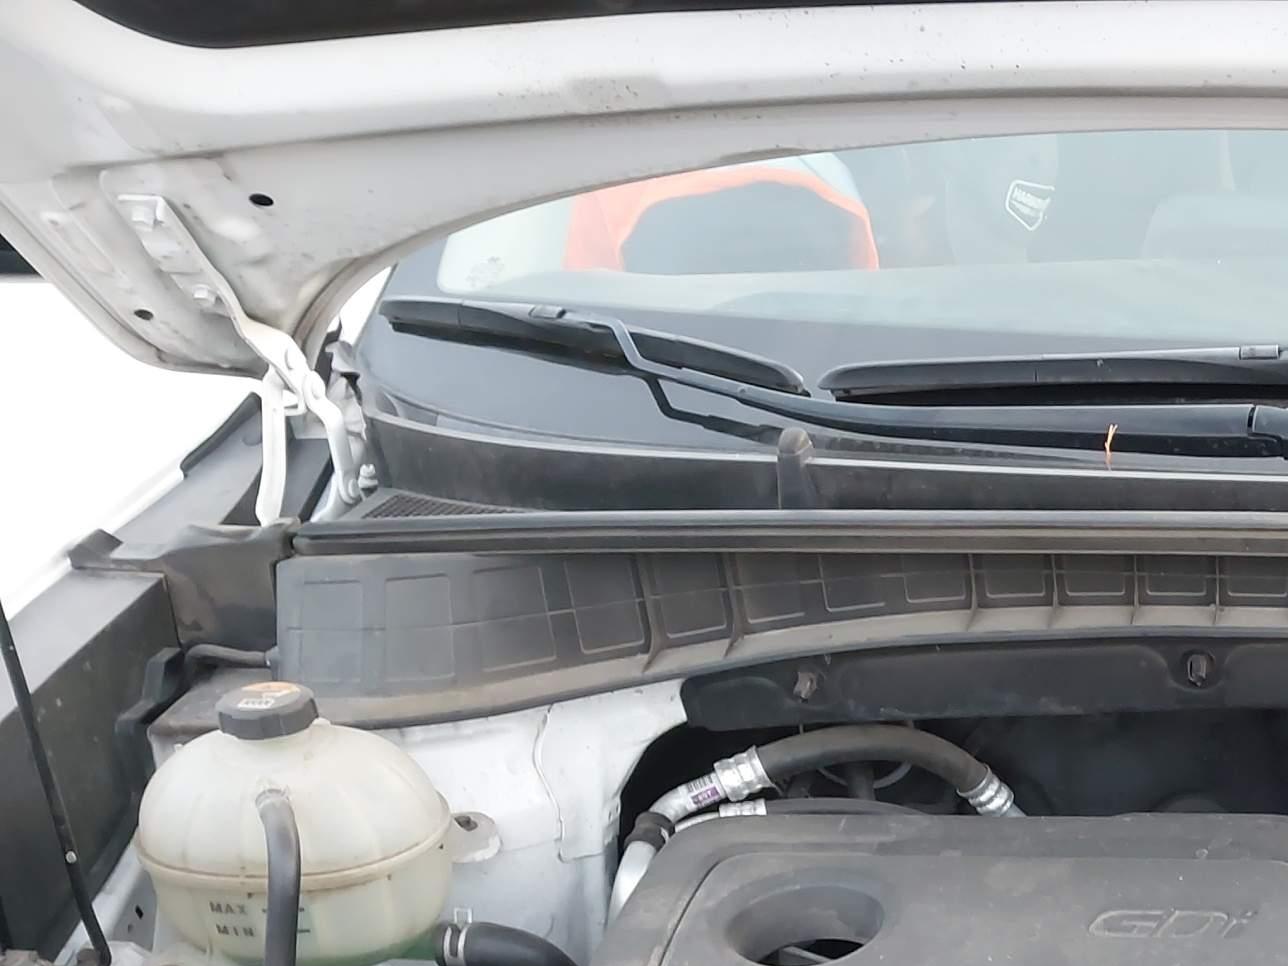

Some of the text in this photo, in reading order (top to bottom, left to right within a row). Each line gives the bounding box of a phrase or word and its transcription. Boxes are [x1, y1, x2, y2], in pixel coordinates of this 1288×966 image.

[209, 901, 247, 915] MAX
[1088, 907, 1258, 938] GDi
[215, 923, 255, 937] MIN
